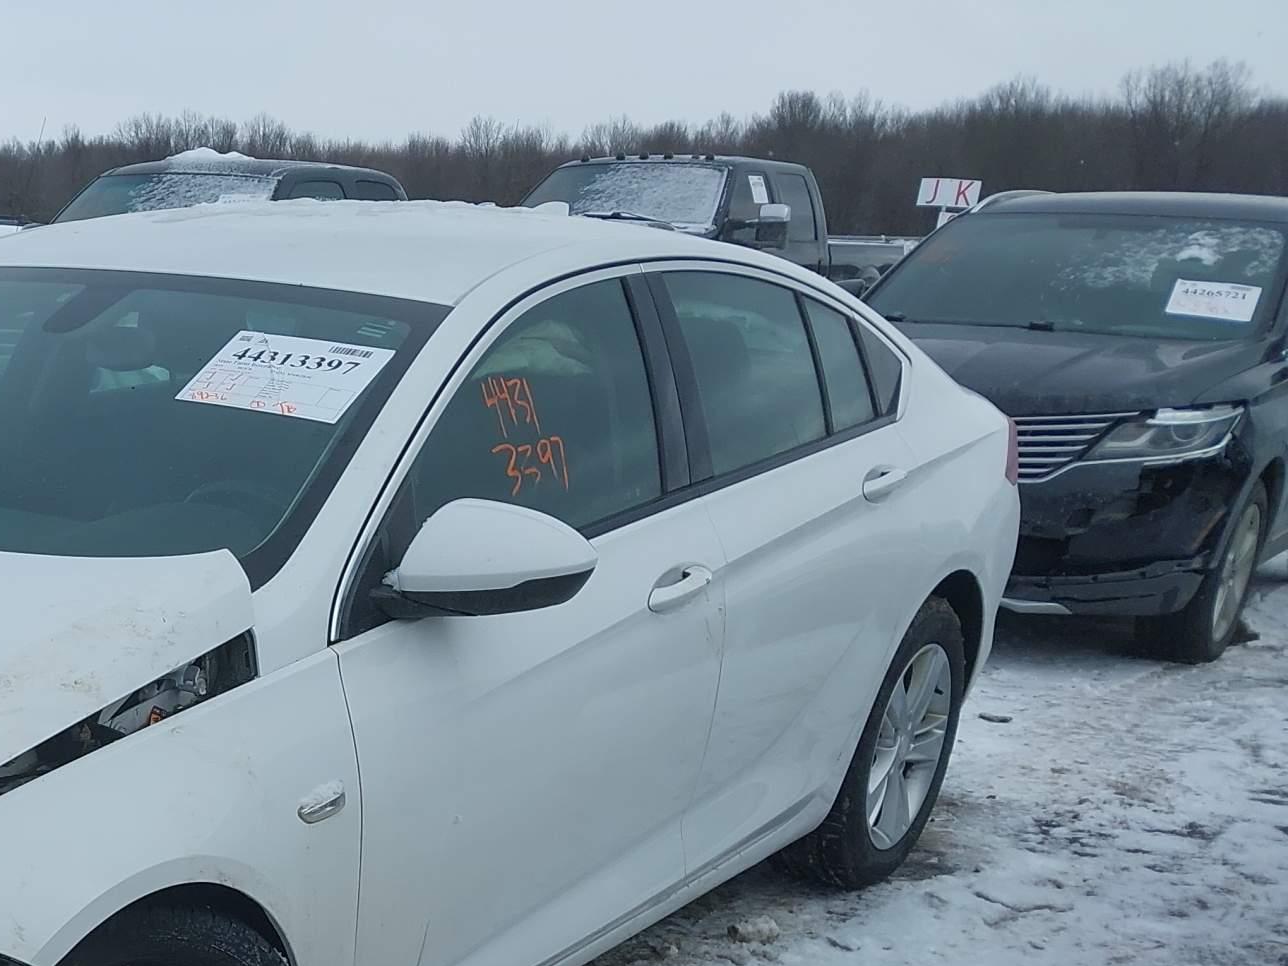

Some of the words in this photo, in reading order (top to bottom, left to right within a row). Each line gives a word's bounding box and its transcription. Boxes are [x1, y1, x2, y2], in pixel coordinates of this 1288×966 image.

[925, 179, 940, 204] J
[954, 180, 975, 206] K
[232, 347, 361, 375] 44313397
[480, 376, 541, 438] 4431
